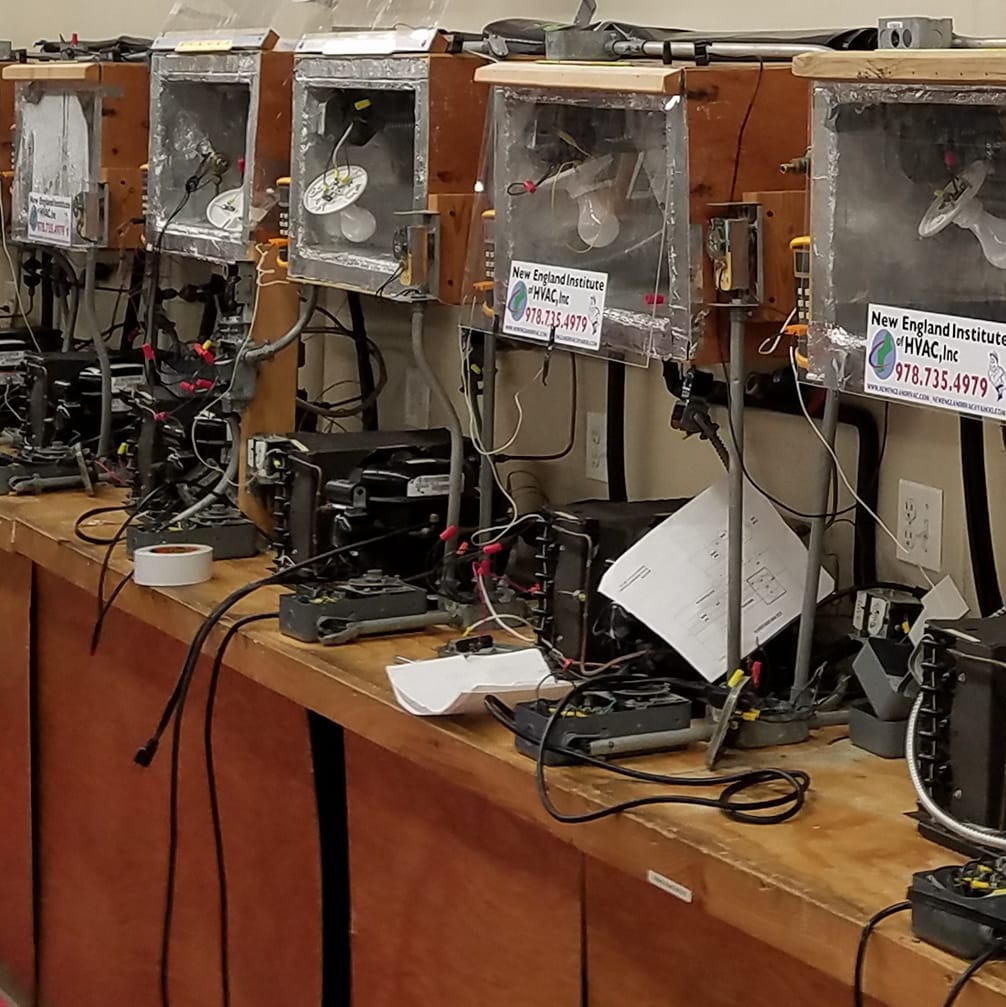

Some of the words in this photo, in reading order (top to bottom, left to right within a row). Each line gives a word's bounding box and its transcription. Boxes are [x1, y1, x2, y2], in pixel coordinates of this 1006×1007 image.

[512, 266, 531, 280] New
[533, 269, 566, 287] England
[566, 273, 605, 292] Institute
[525, 306, 588, 333] 978.735.4979
[871, 310, 898, 329] New
[902, 315, 950, 337] England
[896, 335, 904, 347] of
[895, 362, 988, 398] 978.735.4979
